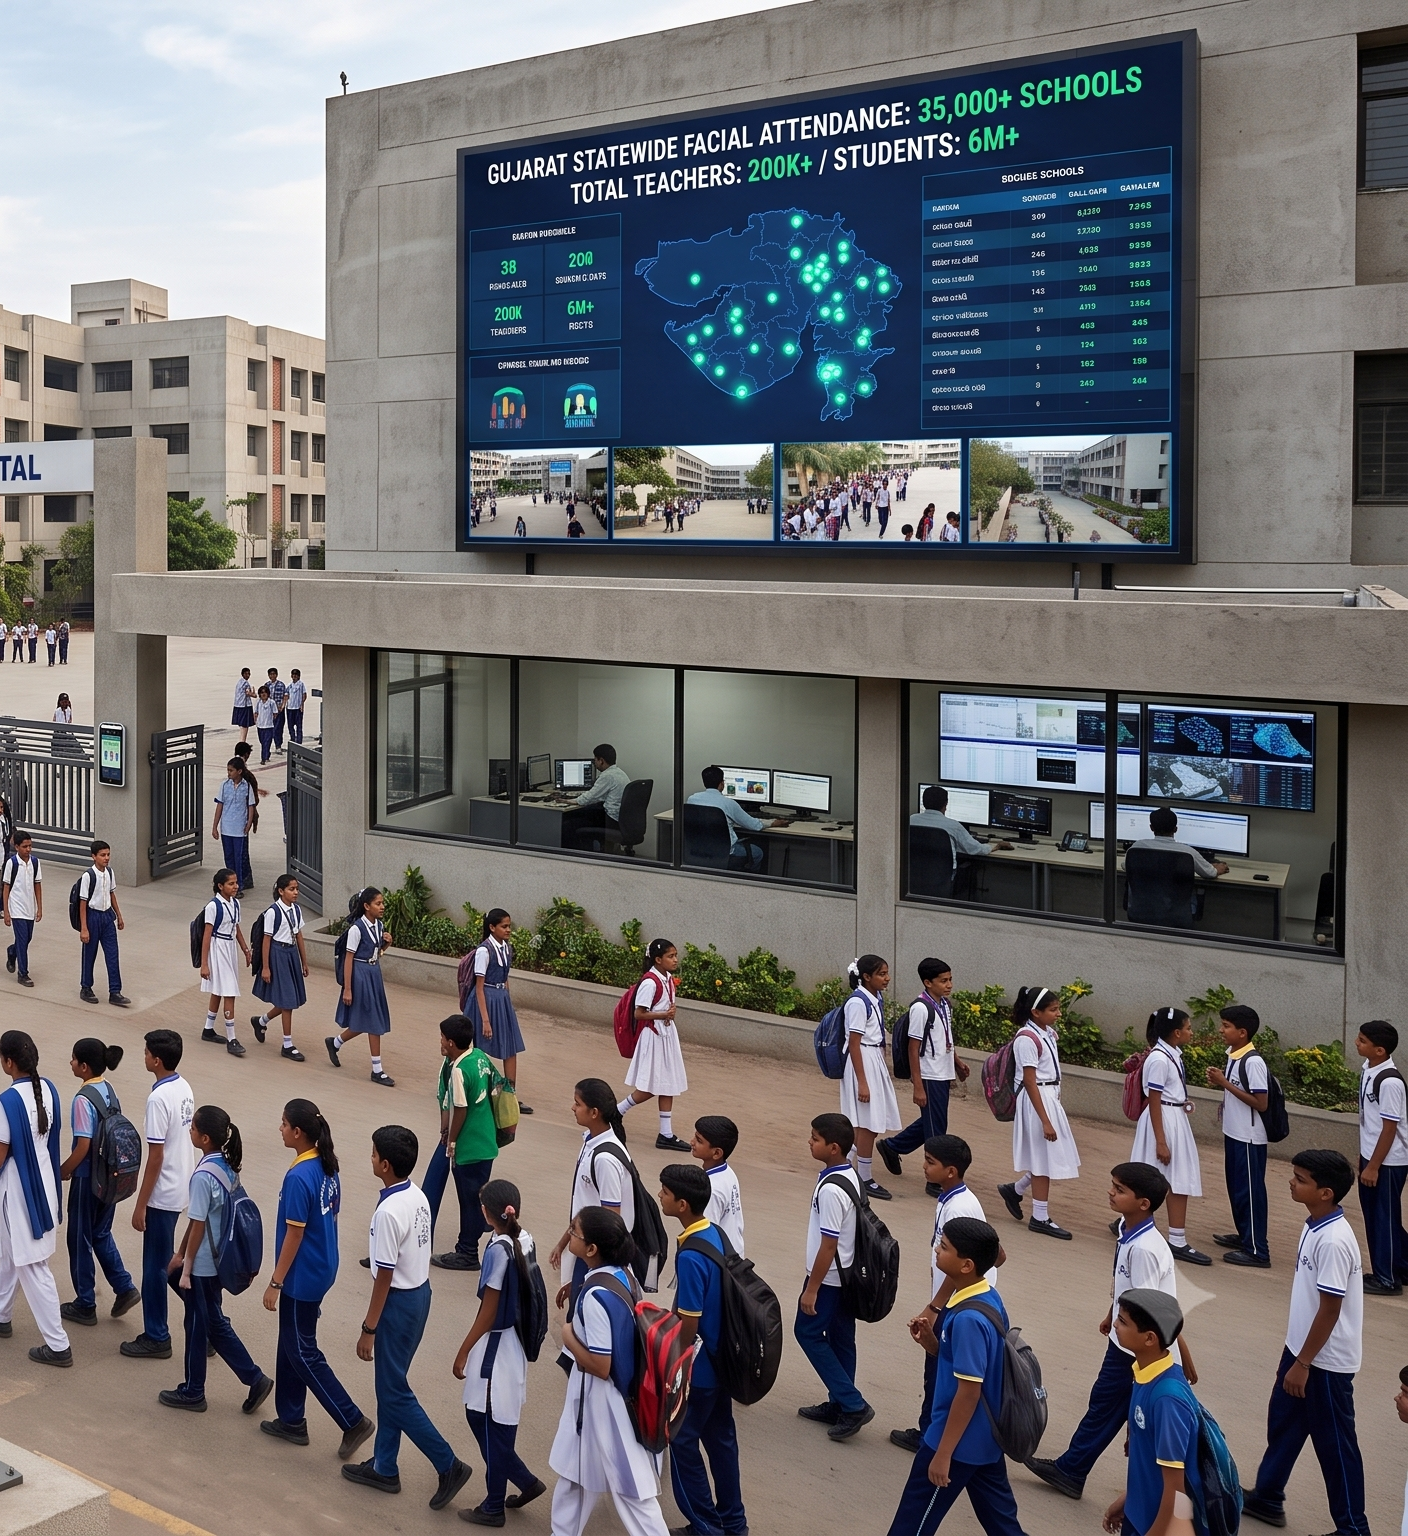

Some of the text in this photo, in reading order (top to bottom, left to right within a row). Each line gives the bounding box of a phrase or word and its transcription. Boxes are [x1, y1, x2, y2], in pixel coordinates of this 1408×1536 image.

[488, 65, 1142, 185] GUJARAT STATEWIDE FACIAL ATTENDANCE: 35,000+ SCHOOLS
[571, 125, 1020, 205] TOTAL TEACHERS: 200K+ / STUDENTS: 6M+
[500, 259, 517, 275] 38
[494, 305, 523, 321] 200K
[567, 300, 594, 316] 6M+
